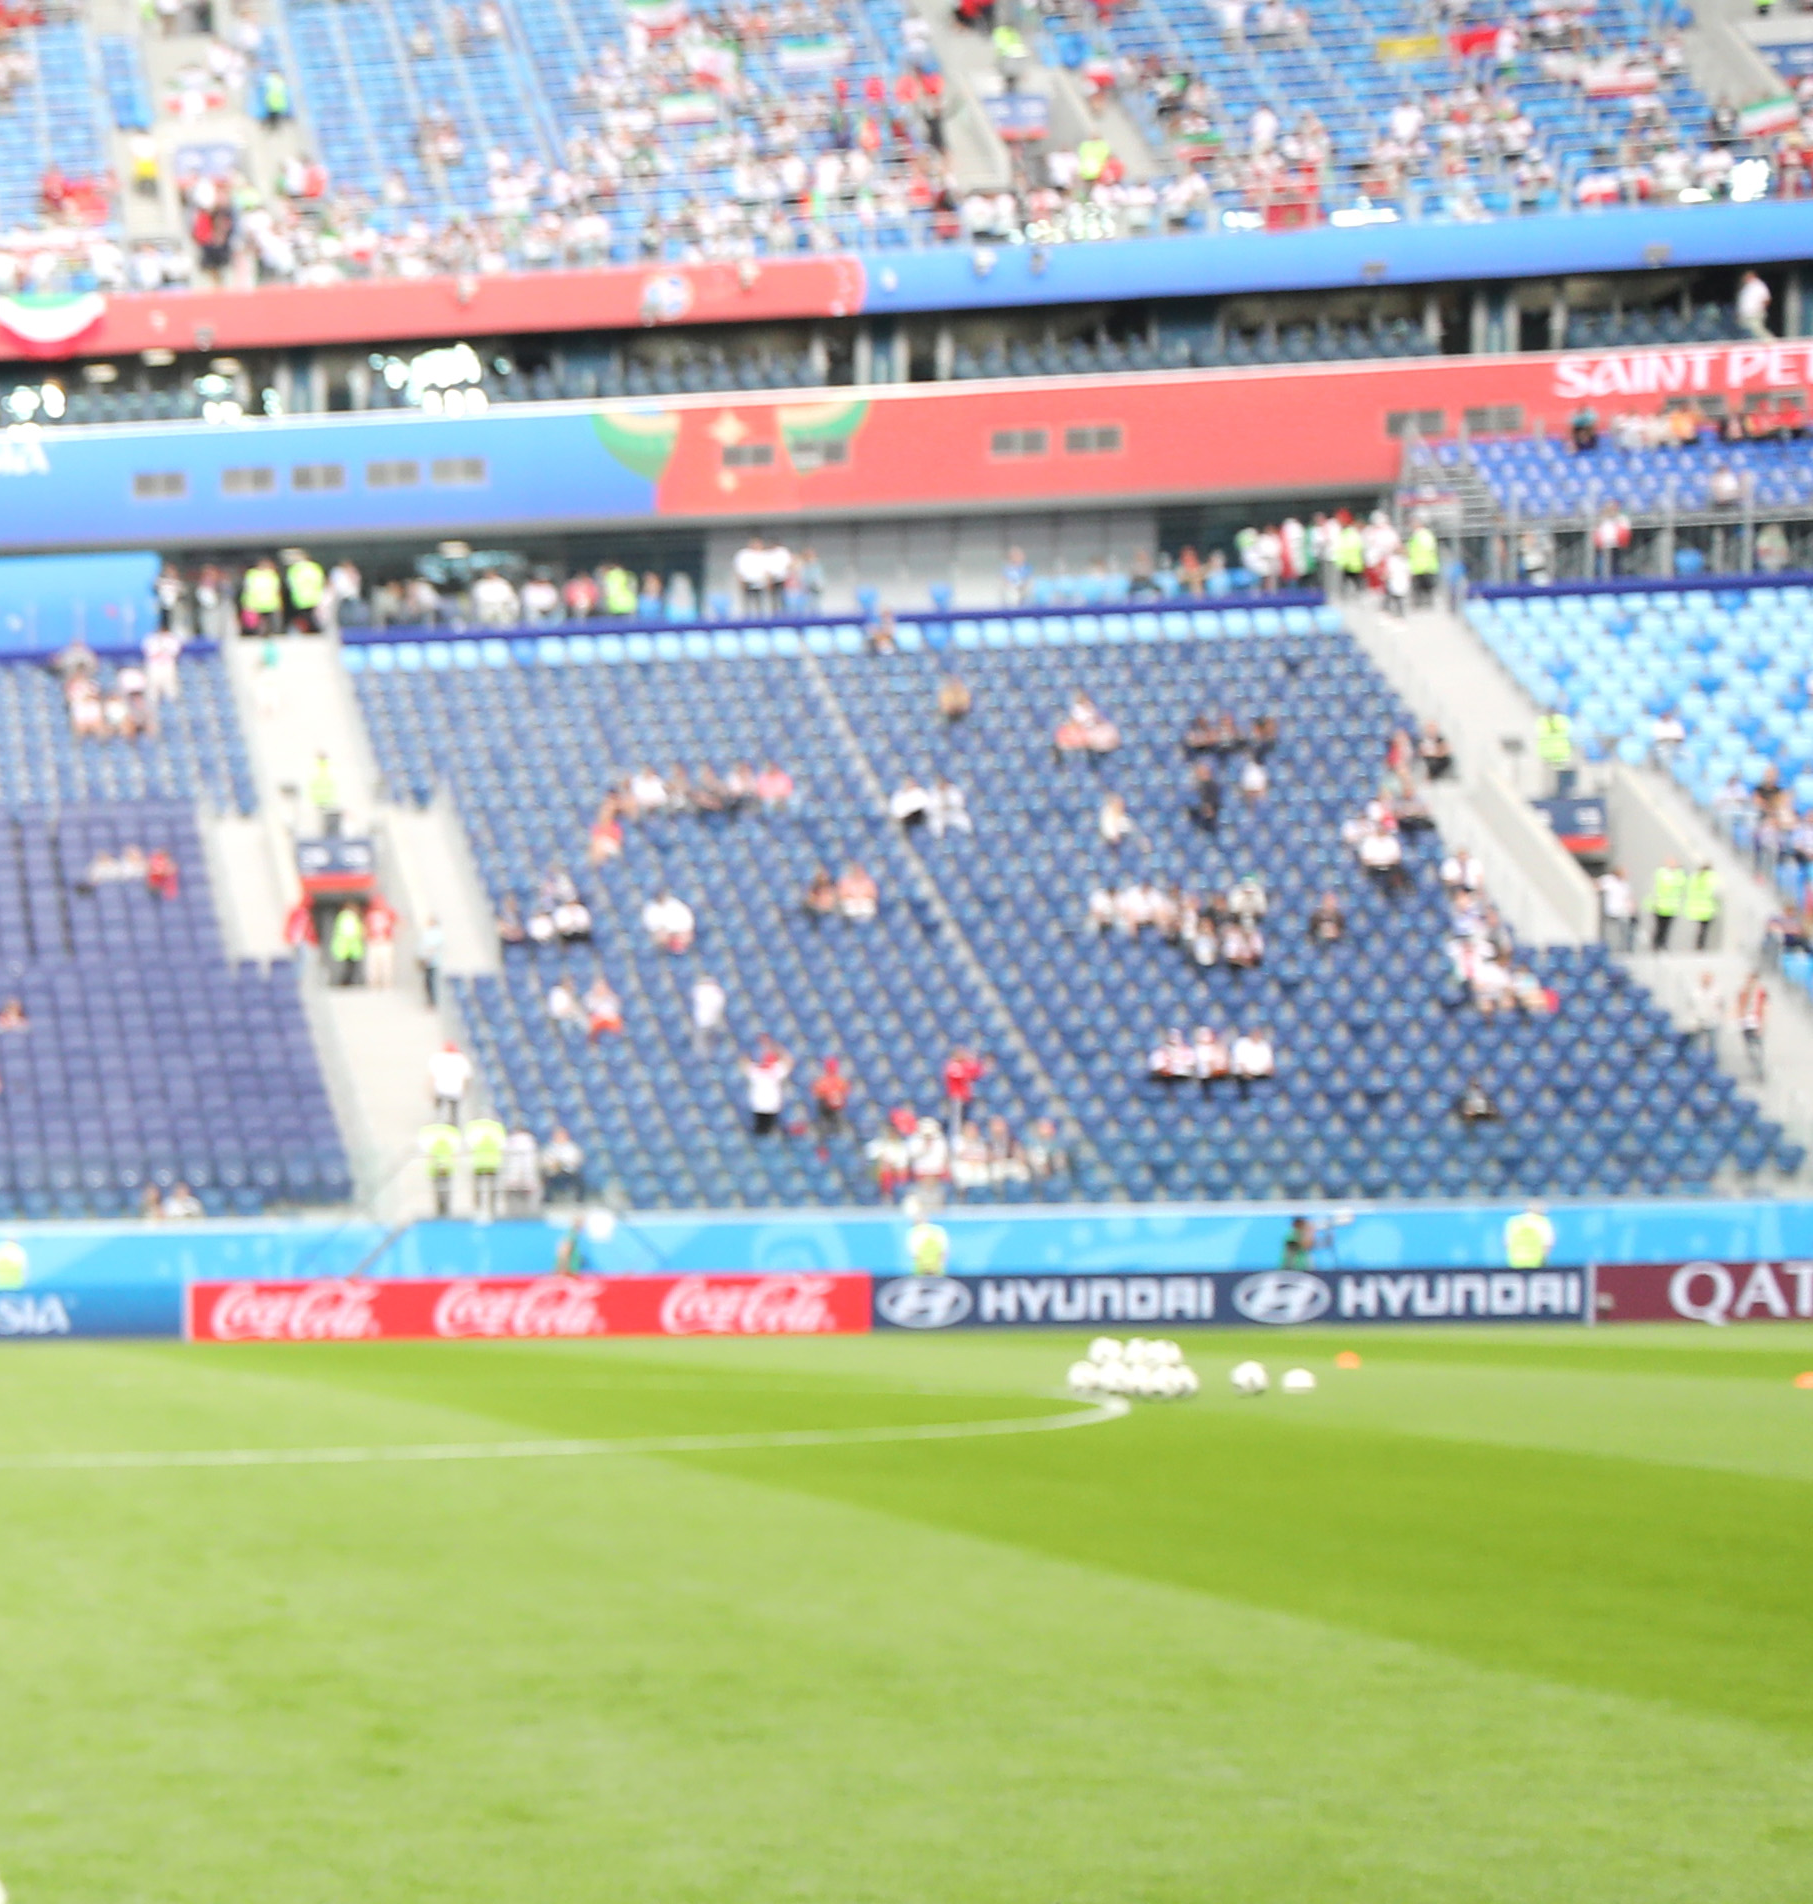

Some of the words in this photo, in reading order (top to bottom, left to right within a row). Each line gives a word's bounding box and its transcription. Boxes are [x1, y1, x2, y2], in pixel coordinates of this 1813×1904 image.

[1553, 352, 1715, 399] SAINT
[1726, 346, 1813, 390] PE
[979, 1276, 1214, 1322] HYUNDAI
[1338, 1271, 1580, 1317] HYUNDAI
